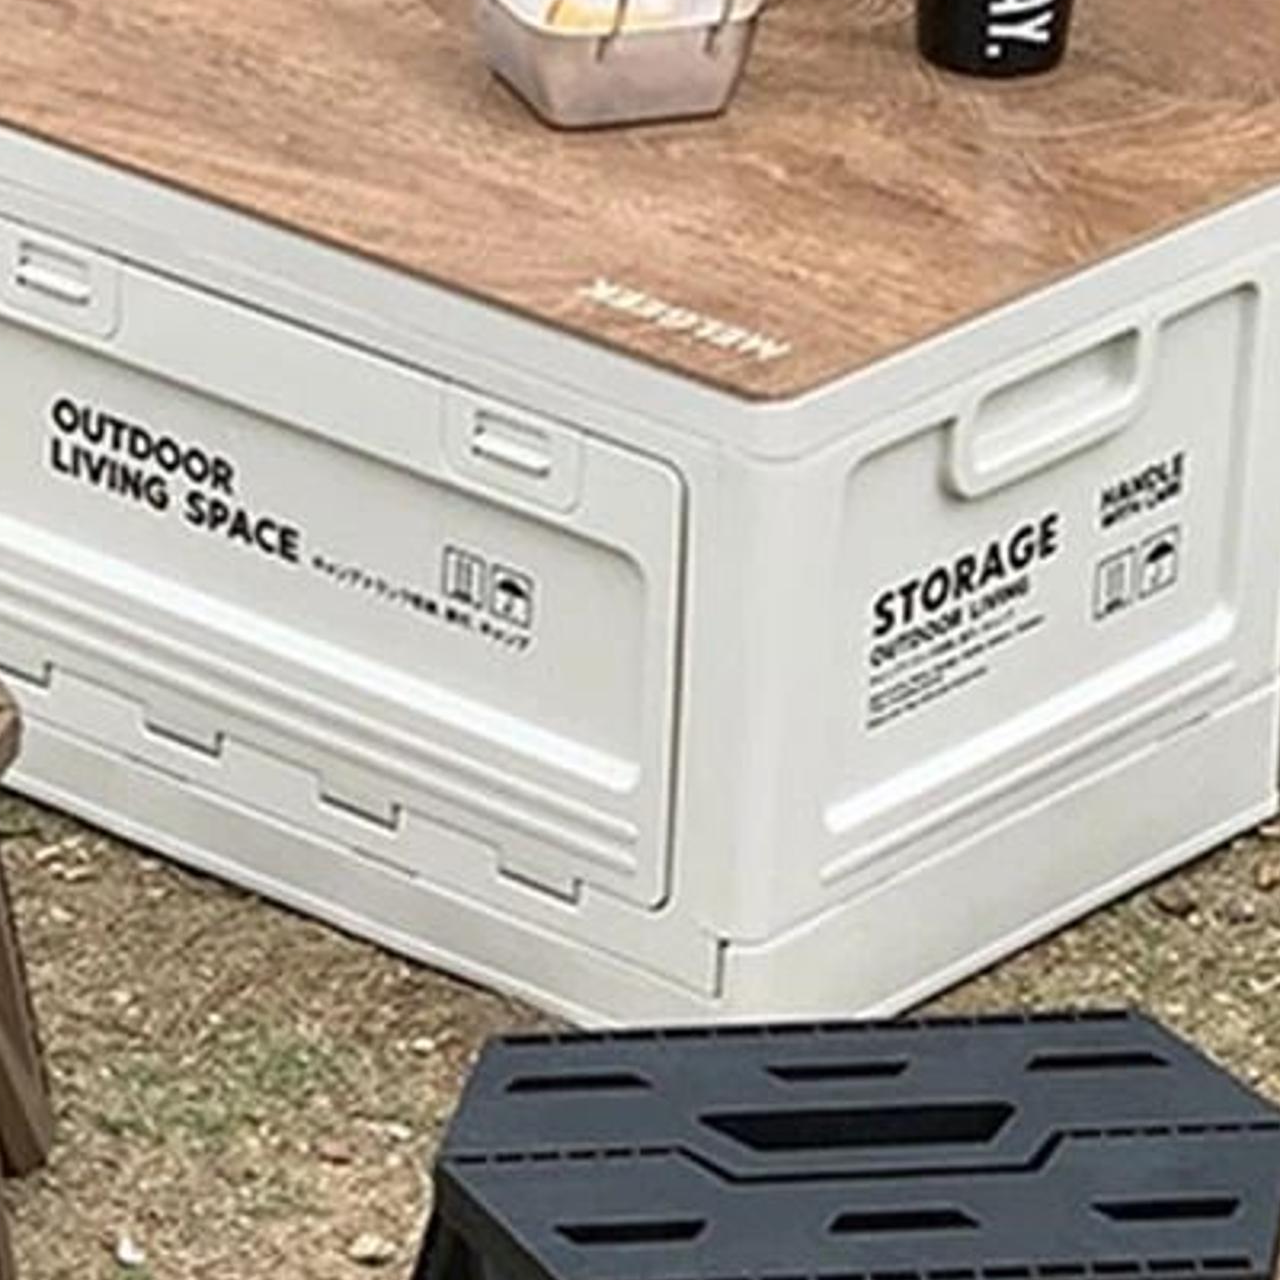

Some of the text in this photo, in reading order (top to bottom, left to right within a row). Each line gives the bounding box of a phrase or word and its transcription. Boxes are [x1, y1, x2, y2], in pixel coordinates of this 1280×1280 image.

[576, 276, 793, 363] MELGEEK
[51, 438, 302, 563] LIVING SPACE
[53, 398, 235, 495] OUTDOOR
[872, 513, 1059, 637] STORAGE
